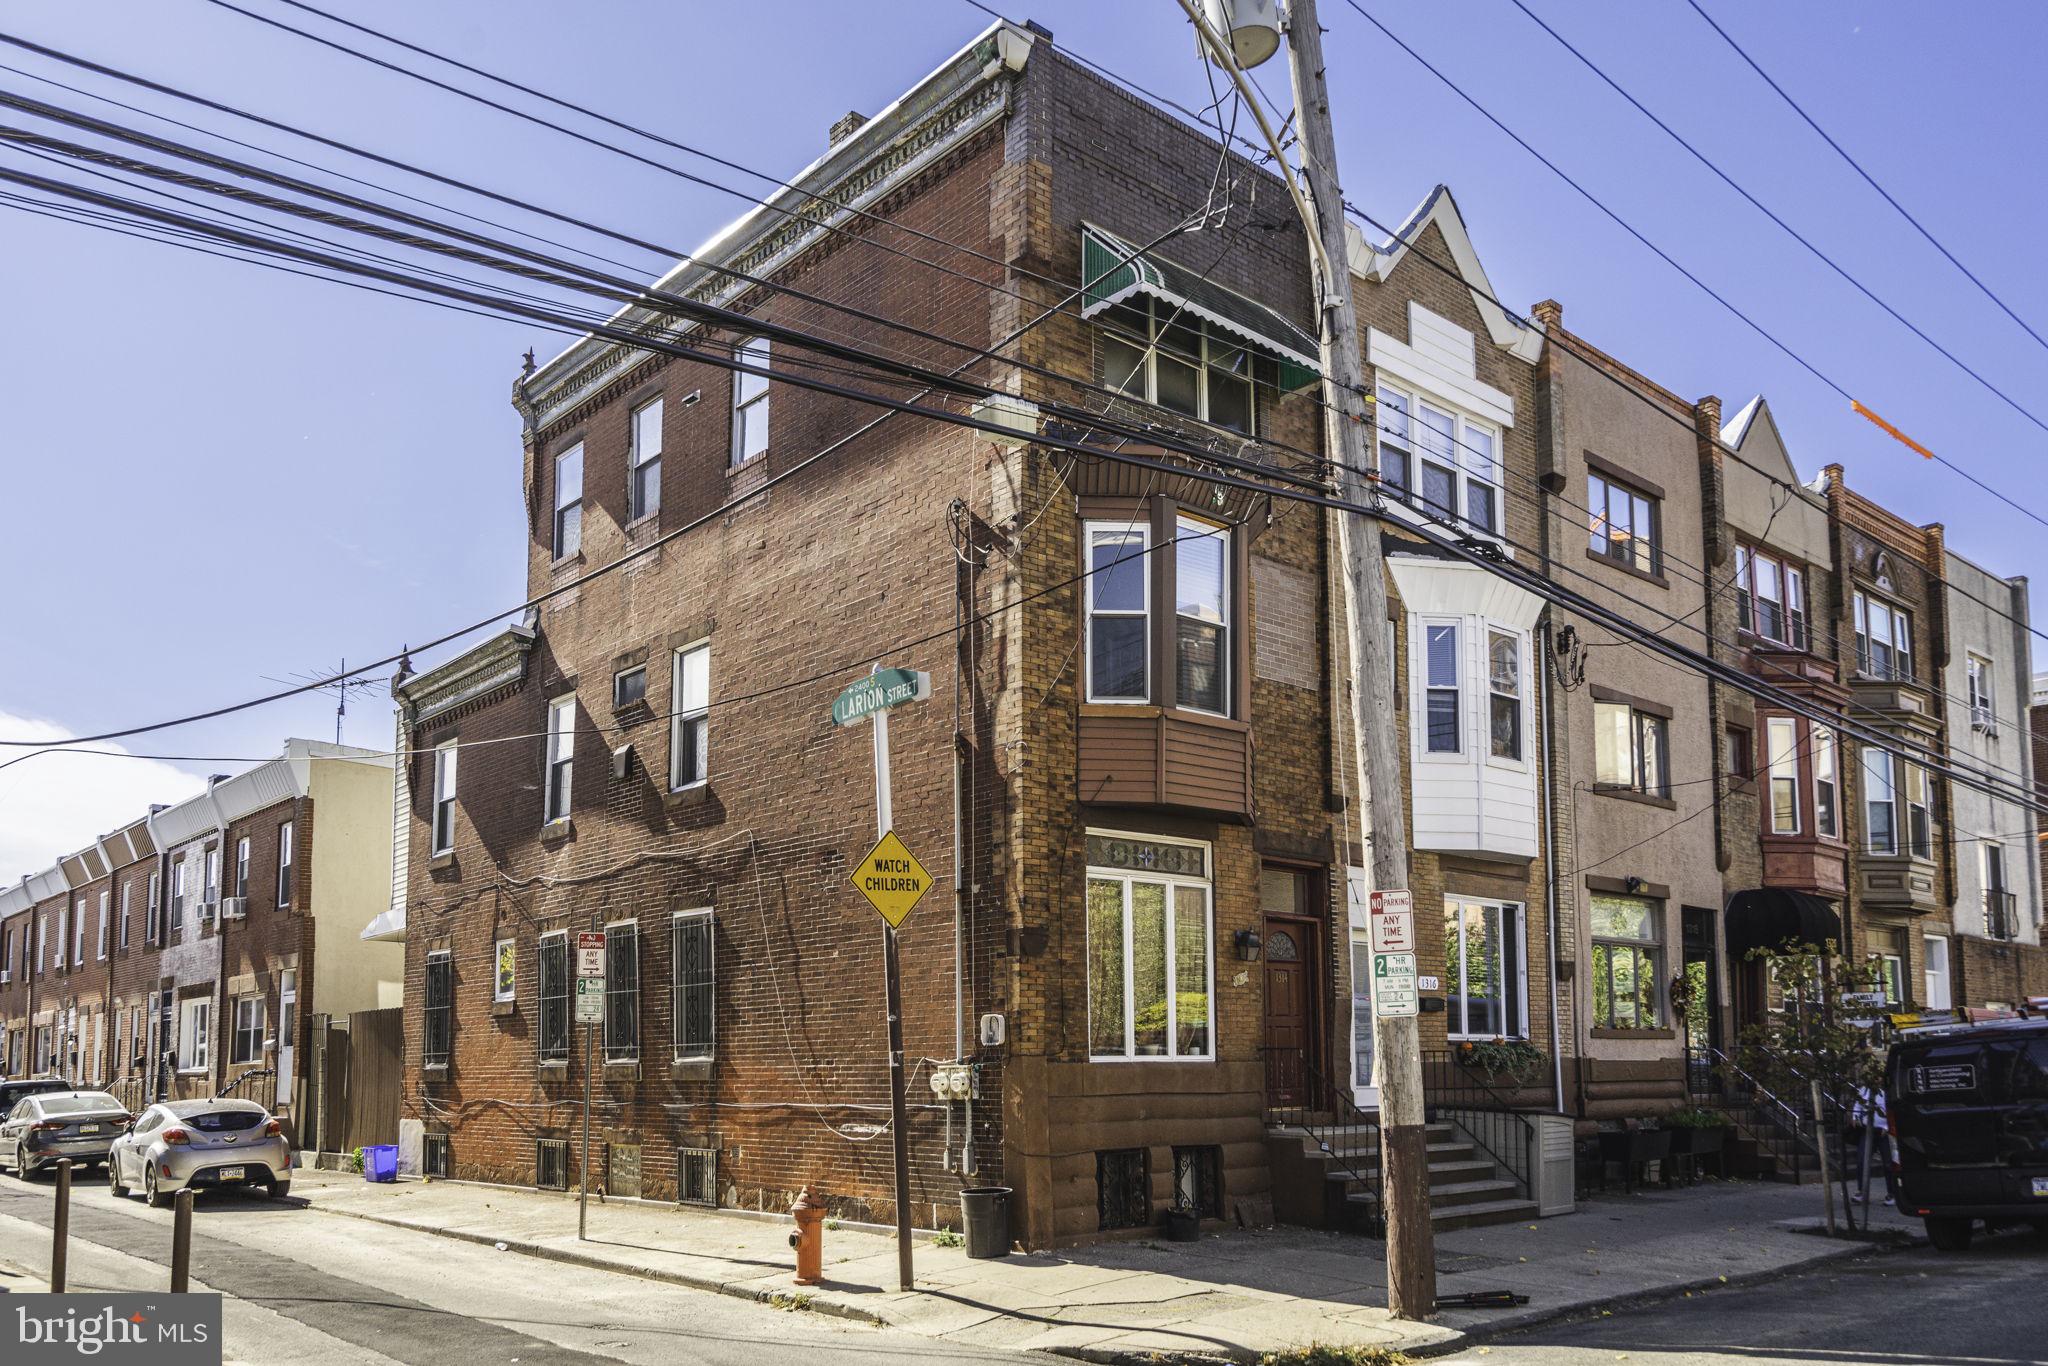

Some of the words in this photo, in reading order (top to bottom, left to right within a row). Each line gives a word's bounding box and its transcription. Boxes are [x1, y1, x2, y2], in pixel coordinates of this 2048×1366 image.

[854, 681, 869, 693] 2400
[869, 677, 876, 688] S
[841, 687, 884, 720] LARION
[887, 680, 917, 703] STREET
[874, 859, 910, 873] WATCH
[865, 877, 920, 892] CHILDREN
[1371, 898, 1382, 910] NO
[1383, 896, 1409, 907] PARKING
[1383, 915, 1400, 925] ANY
[1382, 927, 1403, 937] TIME
[585, 950, 598, 958] ANY
[585, 958, 599, 966] TIME
[1376, 958, 1385, 975] 2
[1394, 956, 1406, 965] HR
[1387, 965, 1414, 975] PARKING
[578, 981, 585, 993] 2
[1421, 978, 1437, 989] 1316
